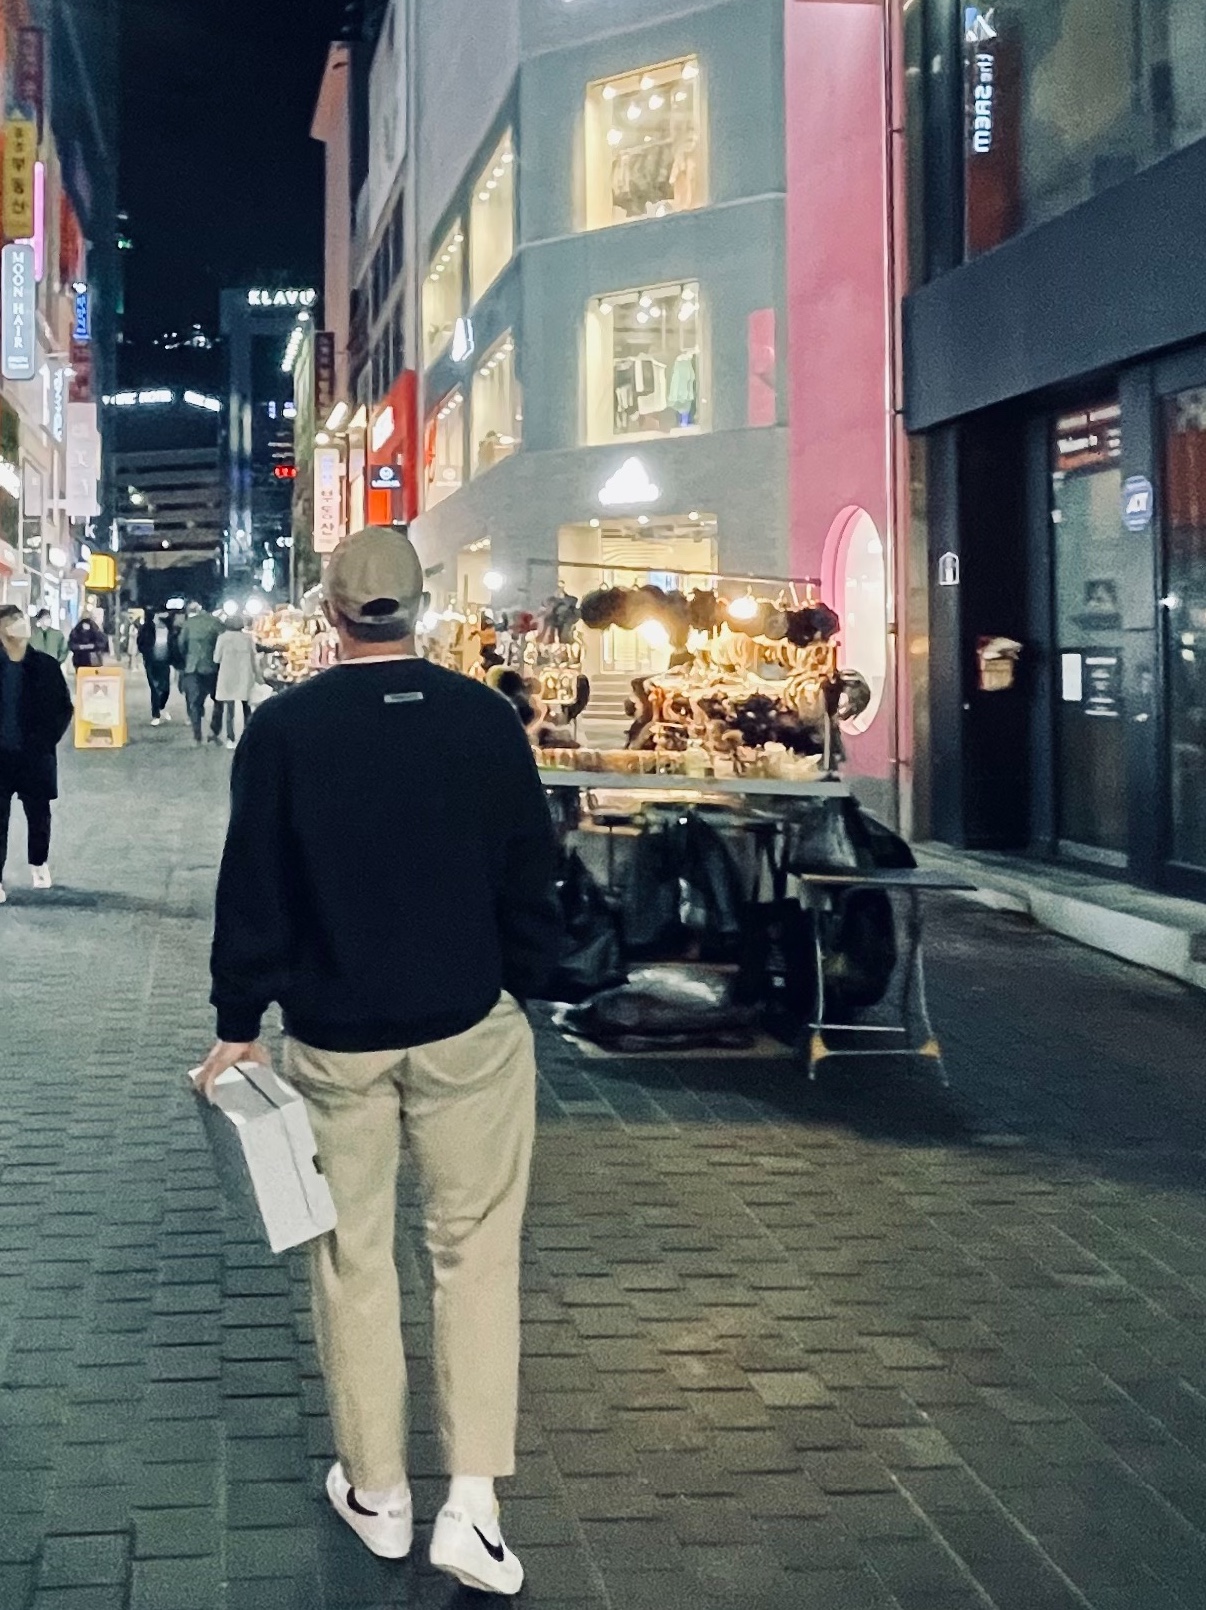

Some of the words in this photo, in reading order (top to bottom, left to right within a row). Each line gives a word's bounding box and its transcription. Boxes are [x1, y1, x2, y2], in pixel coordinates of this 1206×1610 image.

[12, 251, 25, 297] MOON
[13, 302, 25, 348] HAIR
[321, 490, 334, 535] 부동산
